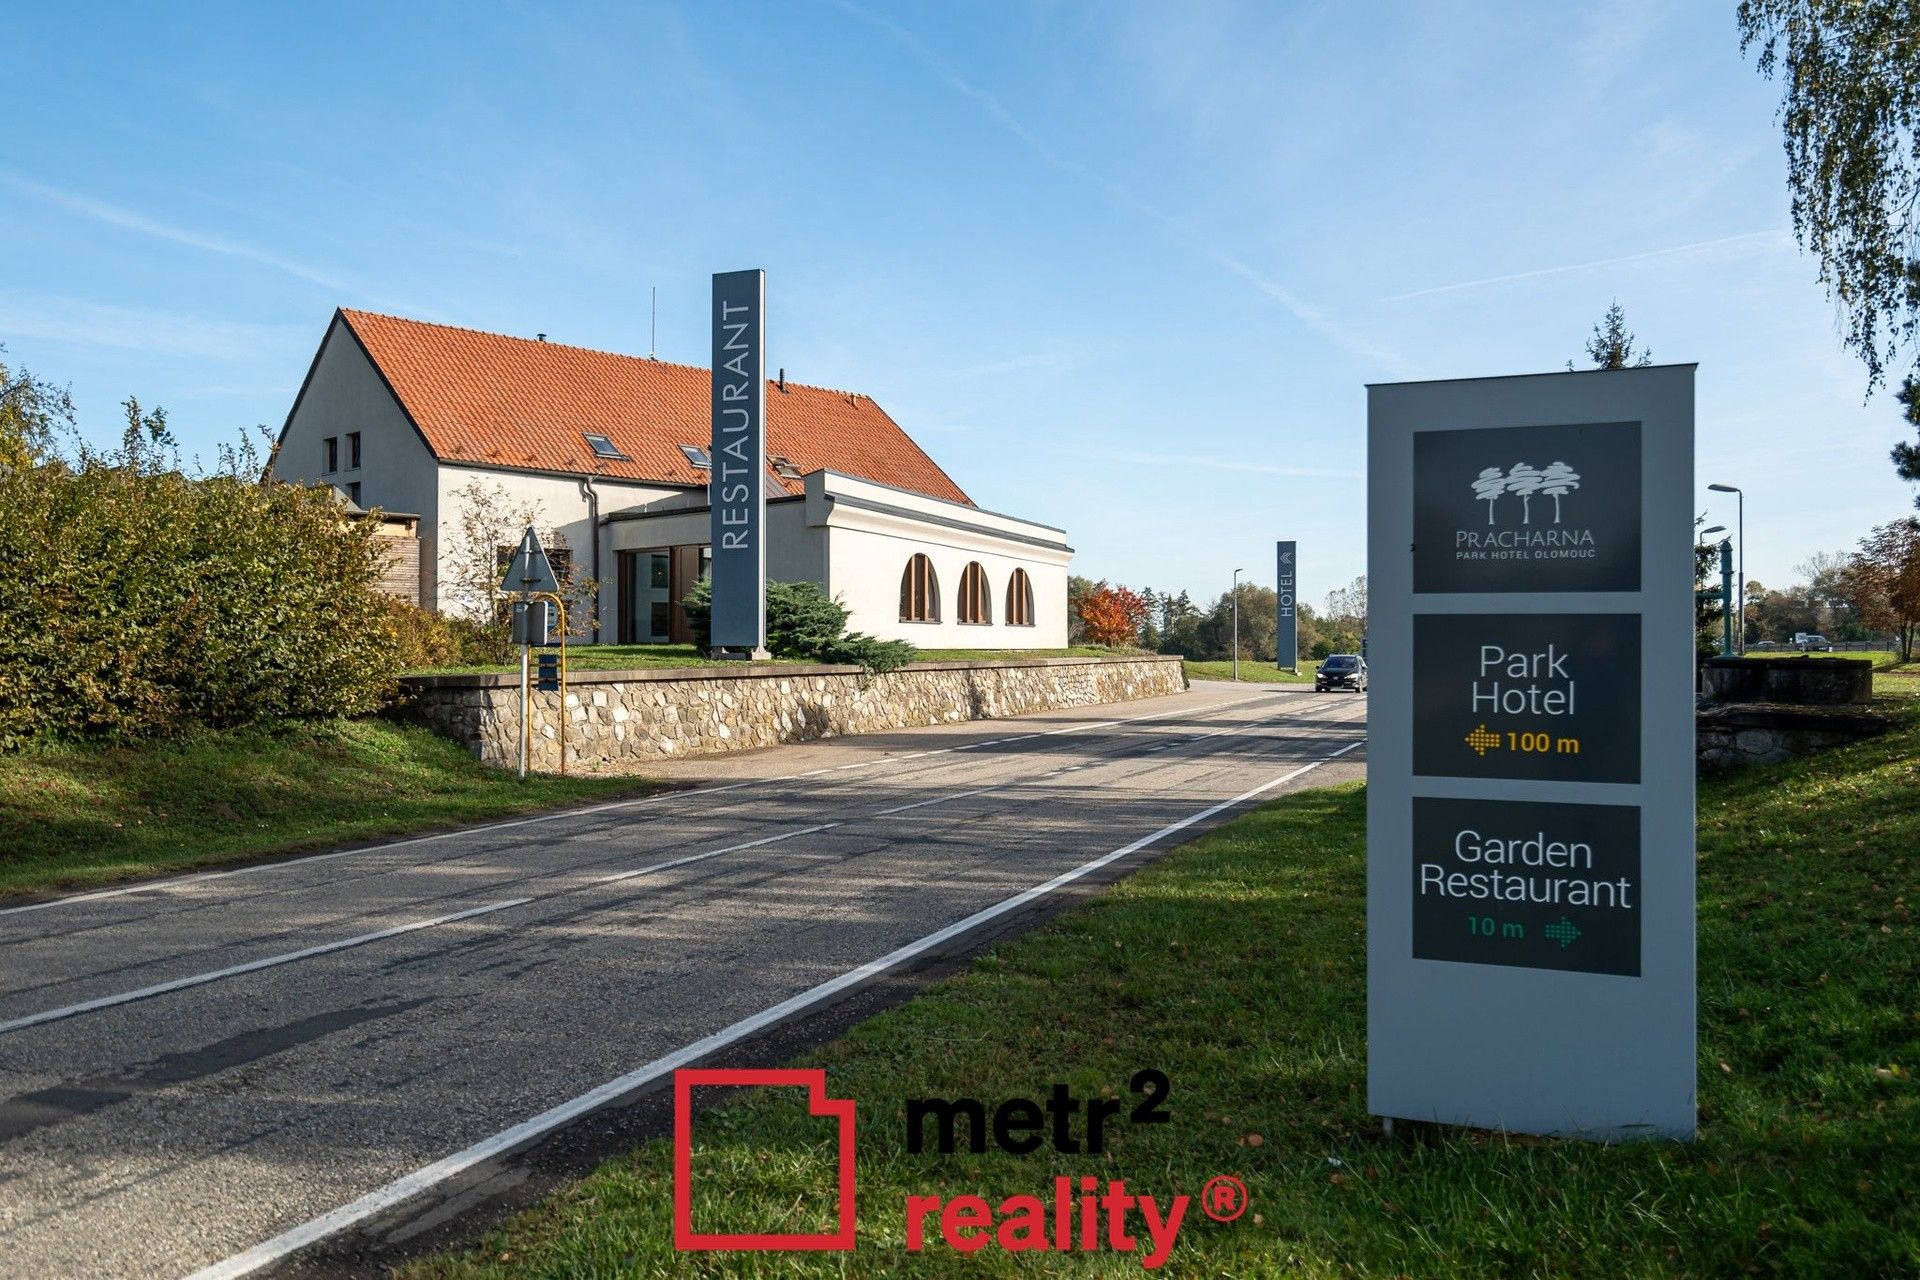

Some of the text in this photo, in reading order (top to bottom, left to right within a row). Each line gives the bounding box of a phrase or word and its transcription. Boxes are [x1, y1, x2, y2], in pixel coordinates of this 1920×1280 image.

[722, 300, 750, 550] RESTAURANT
[1455, 530, 1595, 548] PRACHARNA
[1455, 549, 1596, 560] PARK HOTEL OLOMOUC
[1280, 571, 1293, 617] HOTEL
[1480, 644, 1569, 678] Park
[1472, 681, 1575, 715] Hotel
[1507, 732, 1580, 754] 100 m
[1455, 830, 1592, 869] Garden
[1420, 864, 1632, 908] Restaurant
[1467, 916, 1525, 938] 10 m
